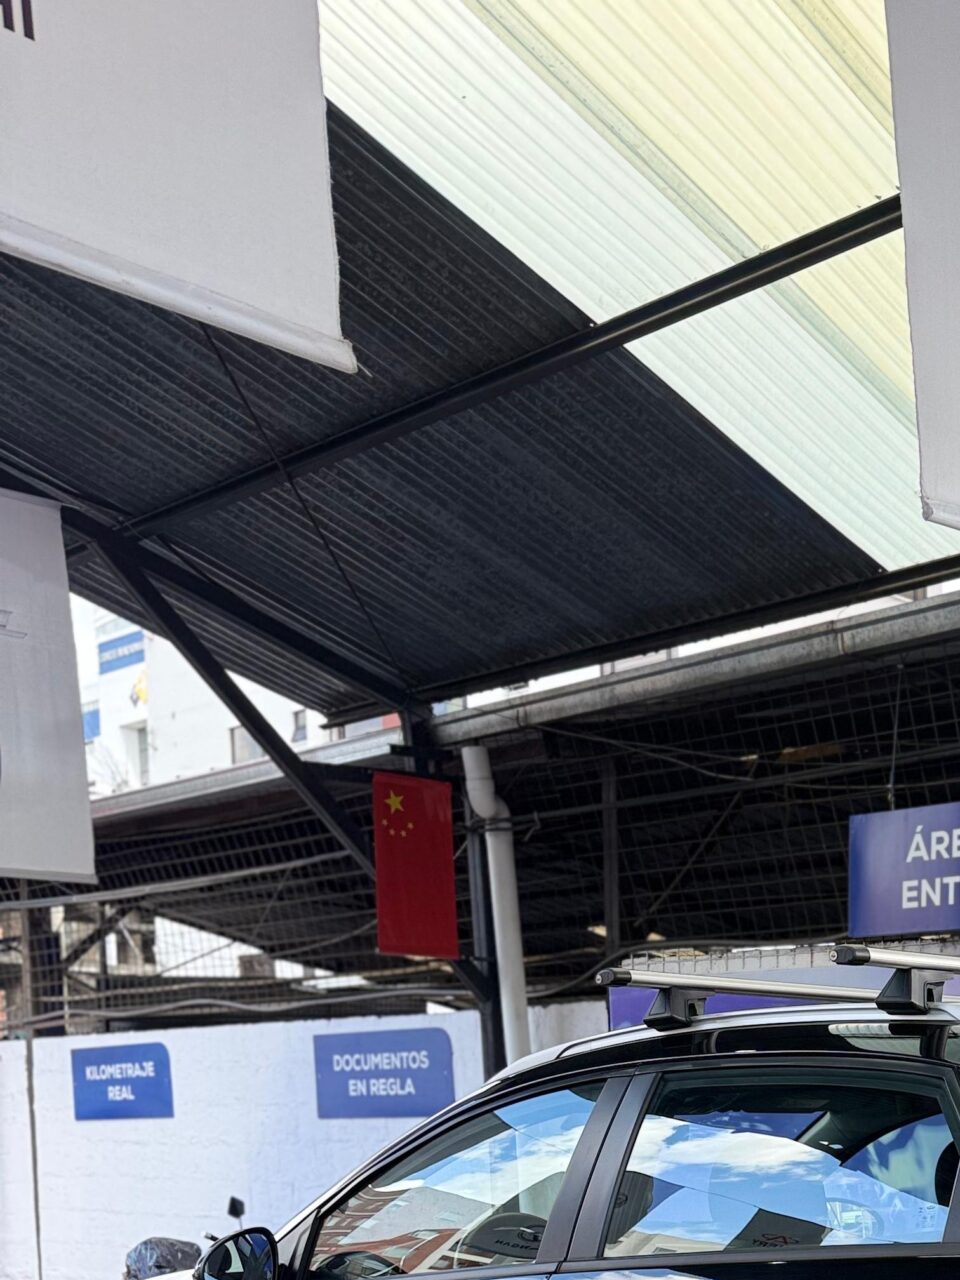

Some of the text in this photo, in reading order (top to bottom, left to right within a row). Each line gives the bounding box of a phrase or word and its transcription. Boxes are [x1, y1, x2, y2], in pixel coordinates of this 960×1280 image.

[85, 1061, 155, 1081] KILOMETRAJE
[332, 1050, 430, 1072] DOCUMENTOS
[107, 1085, 136, 1102] REAL
[348, 1077, 416, 1097] EN REGLA
